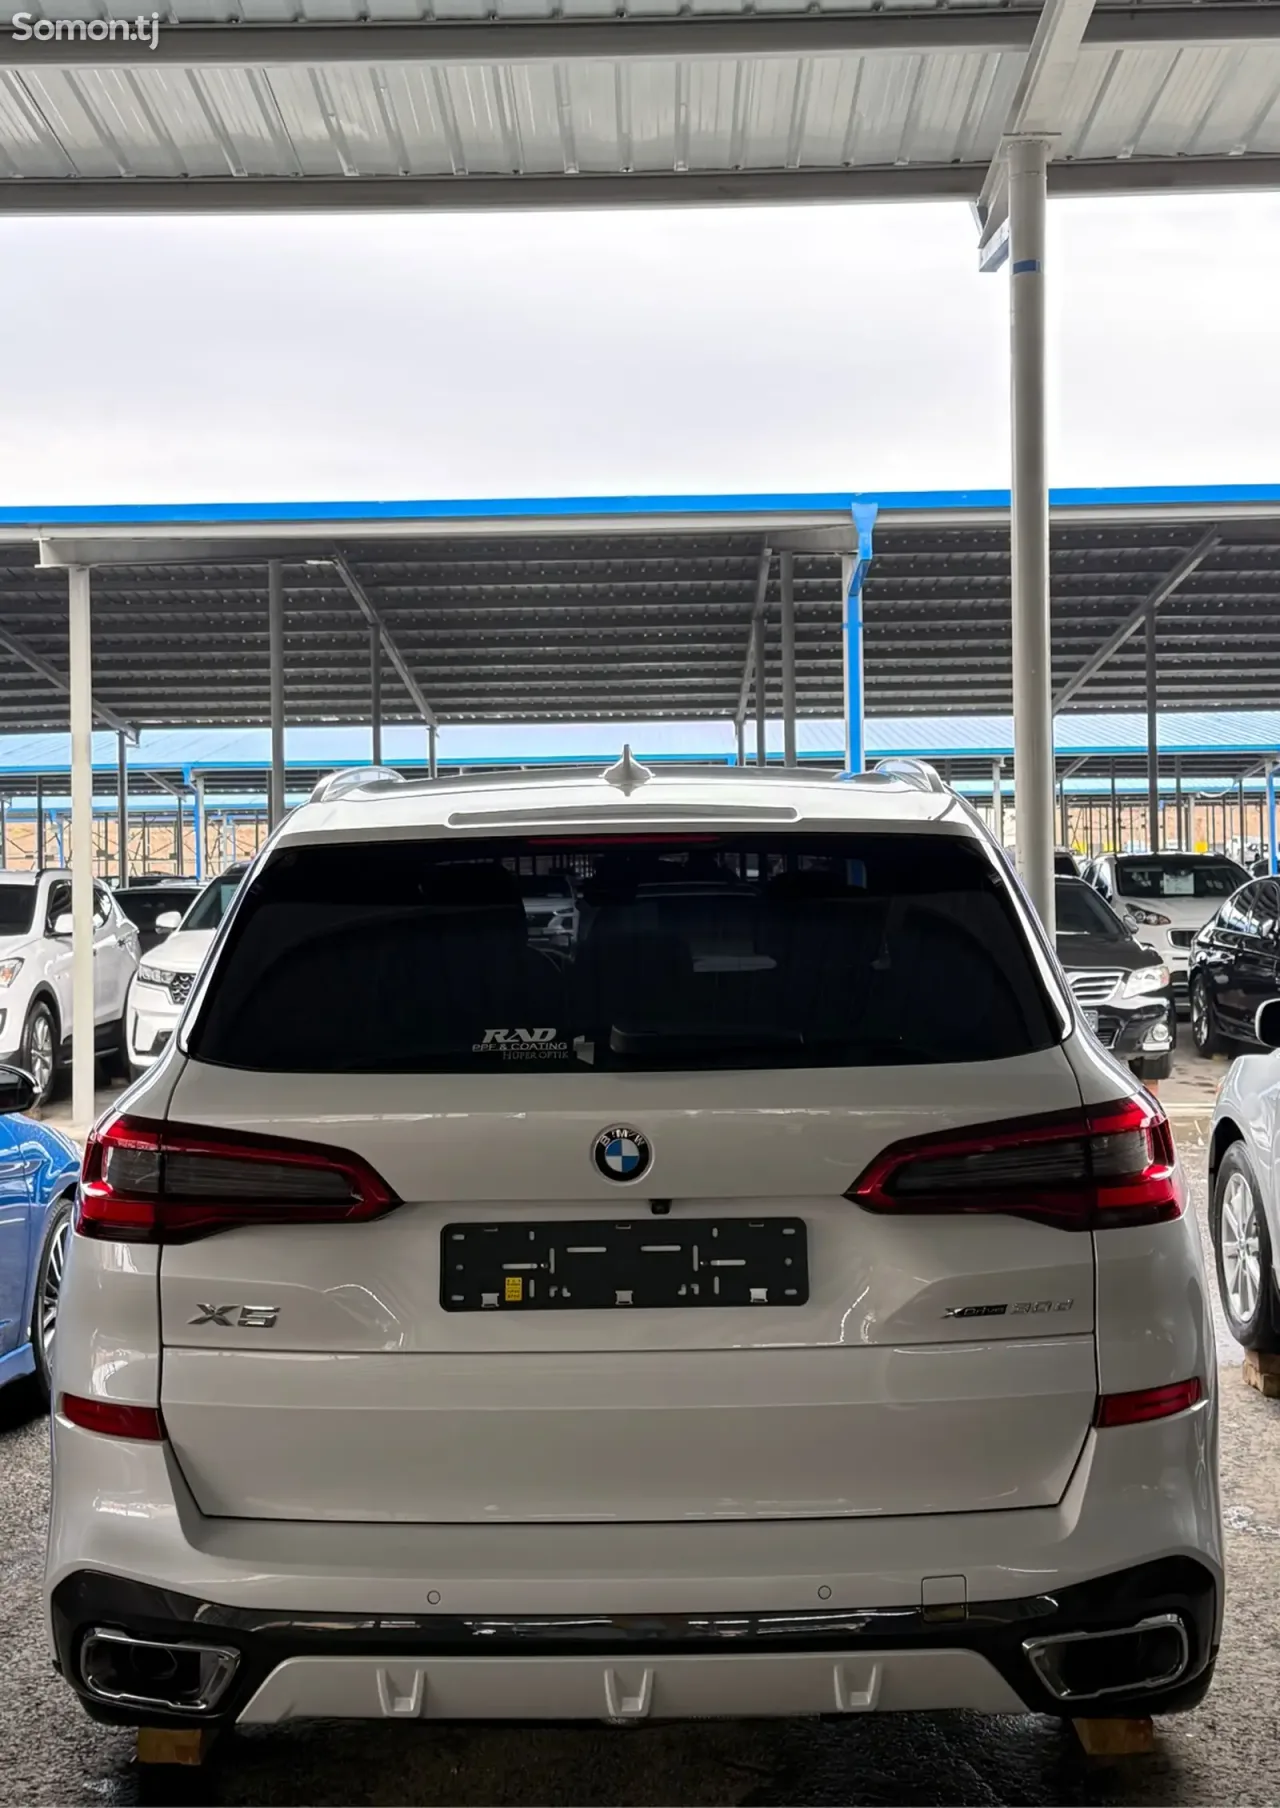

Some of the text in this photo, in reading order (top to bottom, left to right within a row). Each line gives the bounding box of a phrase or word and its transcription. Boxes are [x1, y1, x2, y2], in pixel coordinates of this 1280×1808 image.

[482, 1028, 557, 1044] RAD
[499, 1043, 508, 1051] &
[511, 1042, 568, 1051] COATING
[600, 1129, 645, 1147] BMW
[187, 1304, 281, 1328] X5
